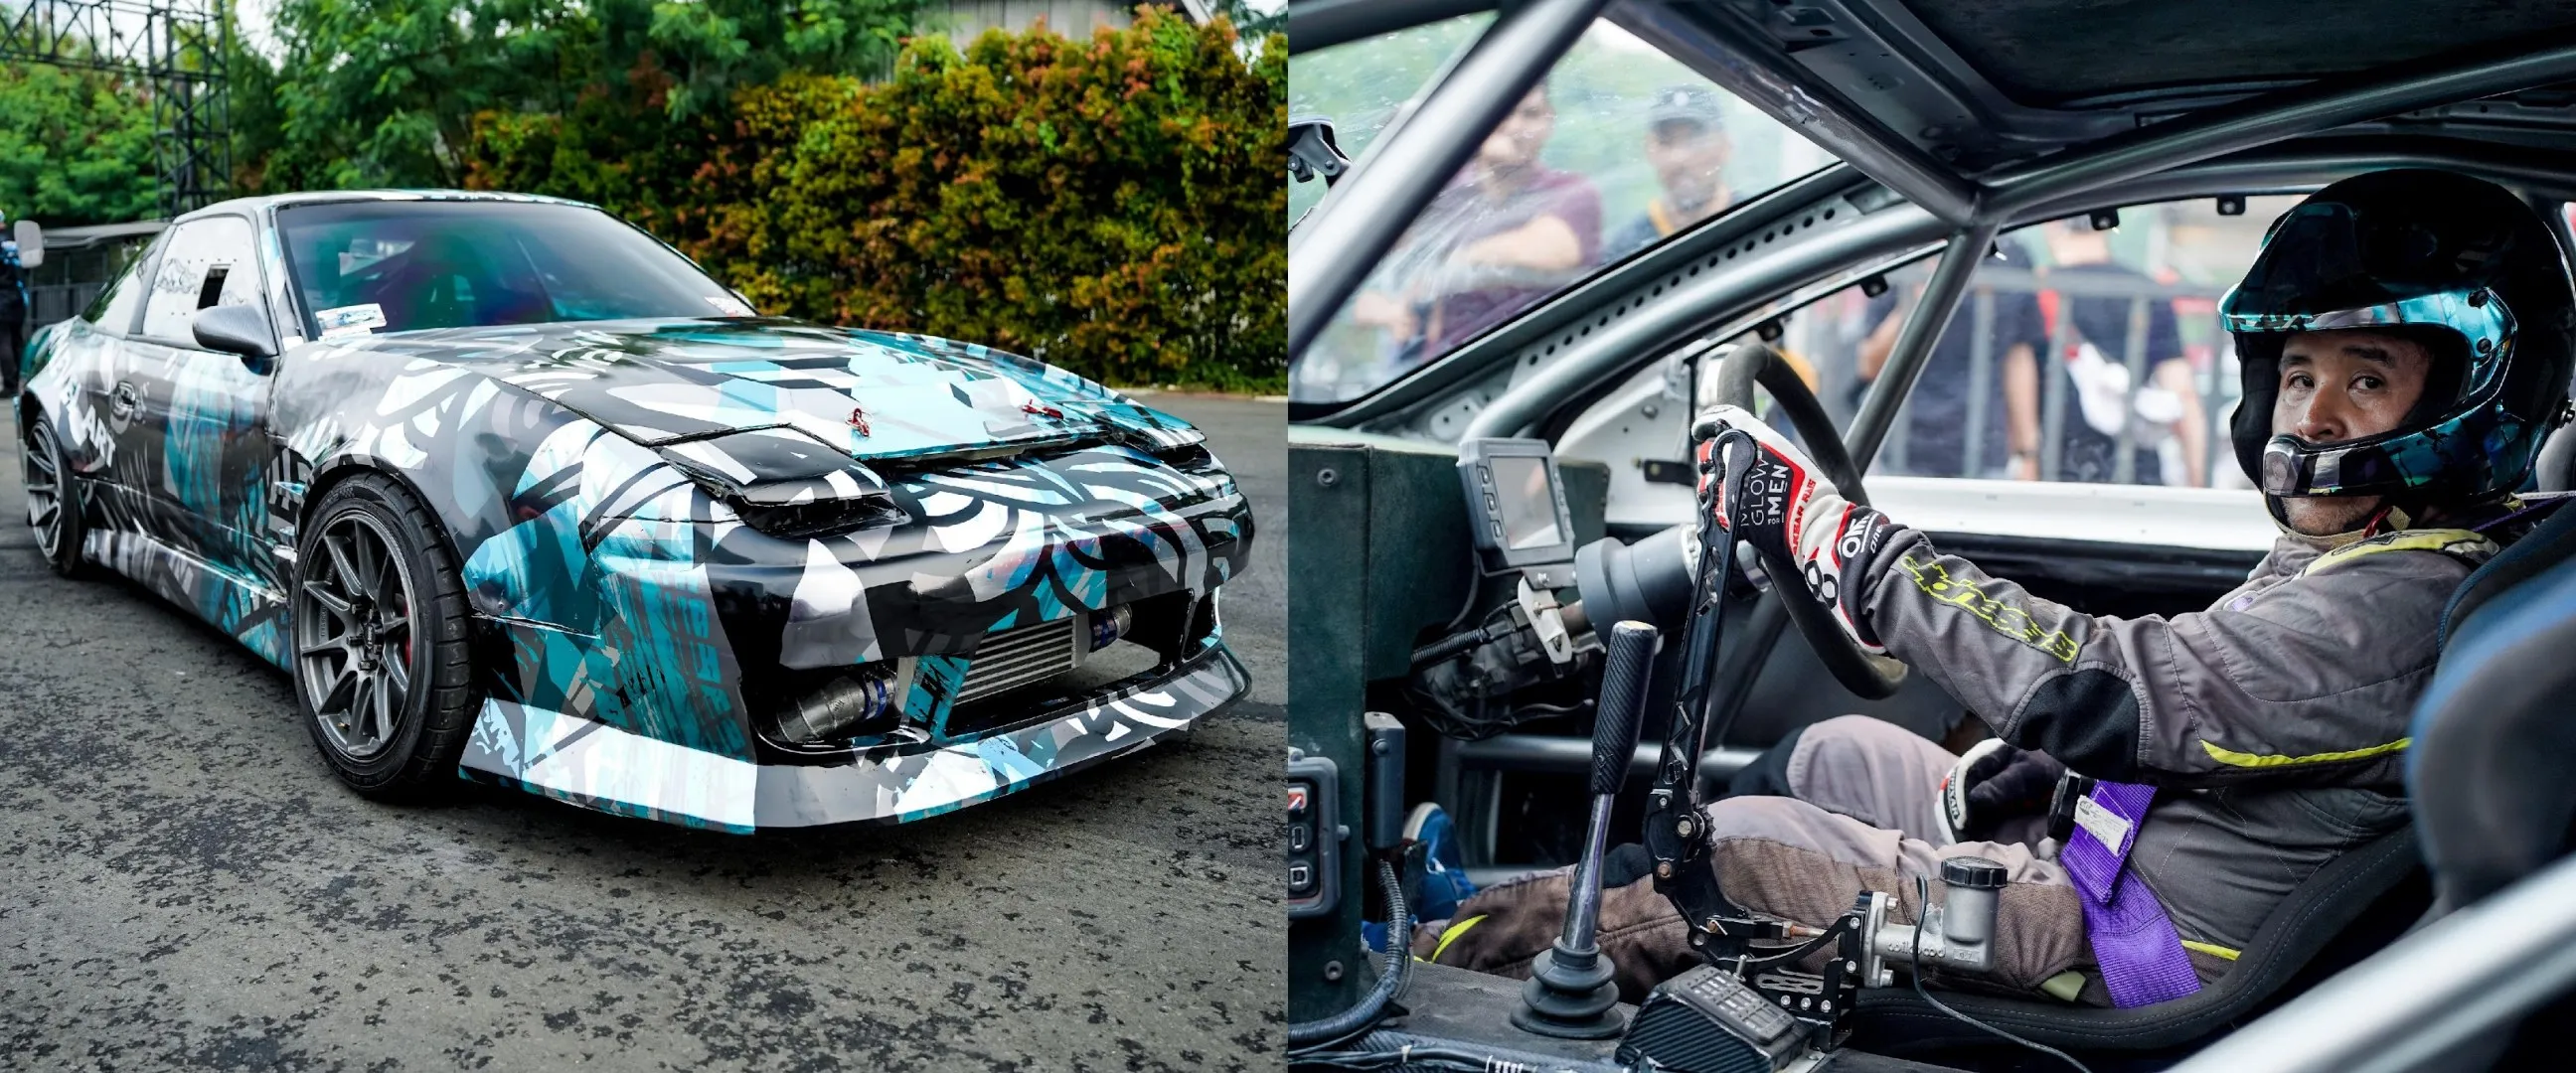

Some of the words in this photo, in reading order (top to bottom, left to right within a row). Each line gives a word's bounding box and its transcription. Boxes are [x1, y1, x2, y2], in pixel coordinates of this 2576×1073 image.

[82, 404, 116, 468] ART
[1750, 449, 1769, 527] GLOW
[1768, 464, 1789, 517] MEN
